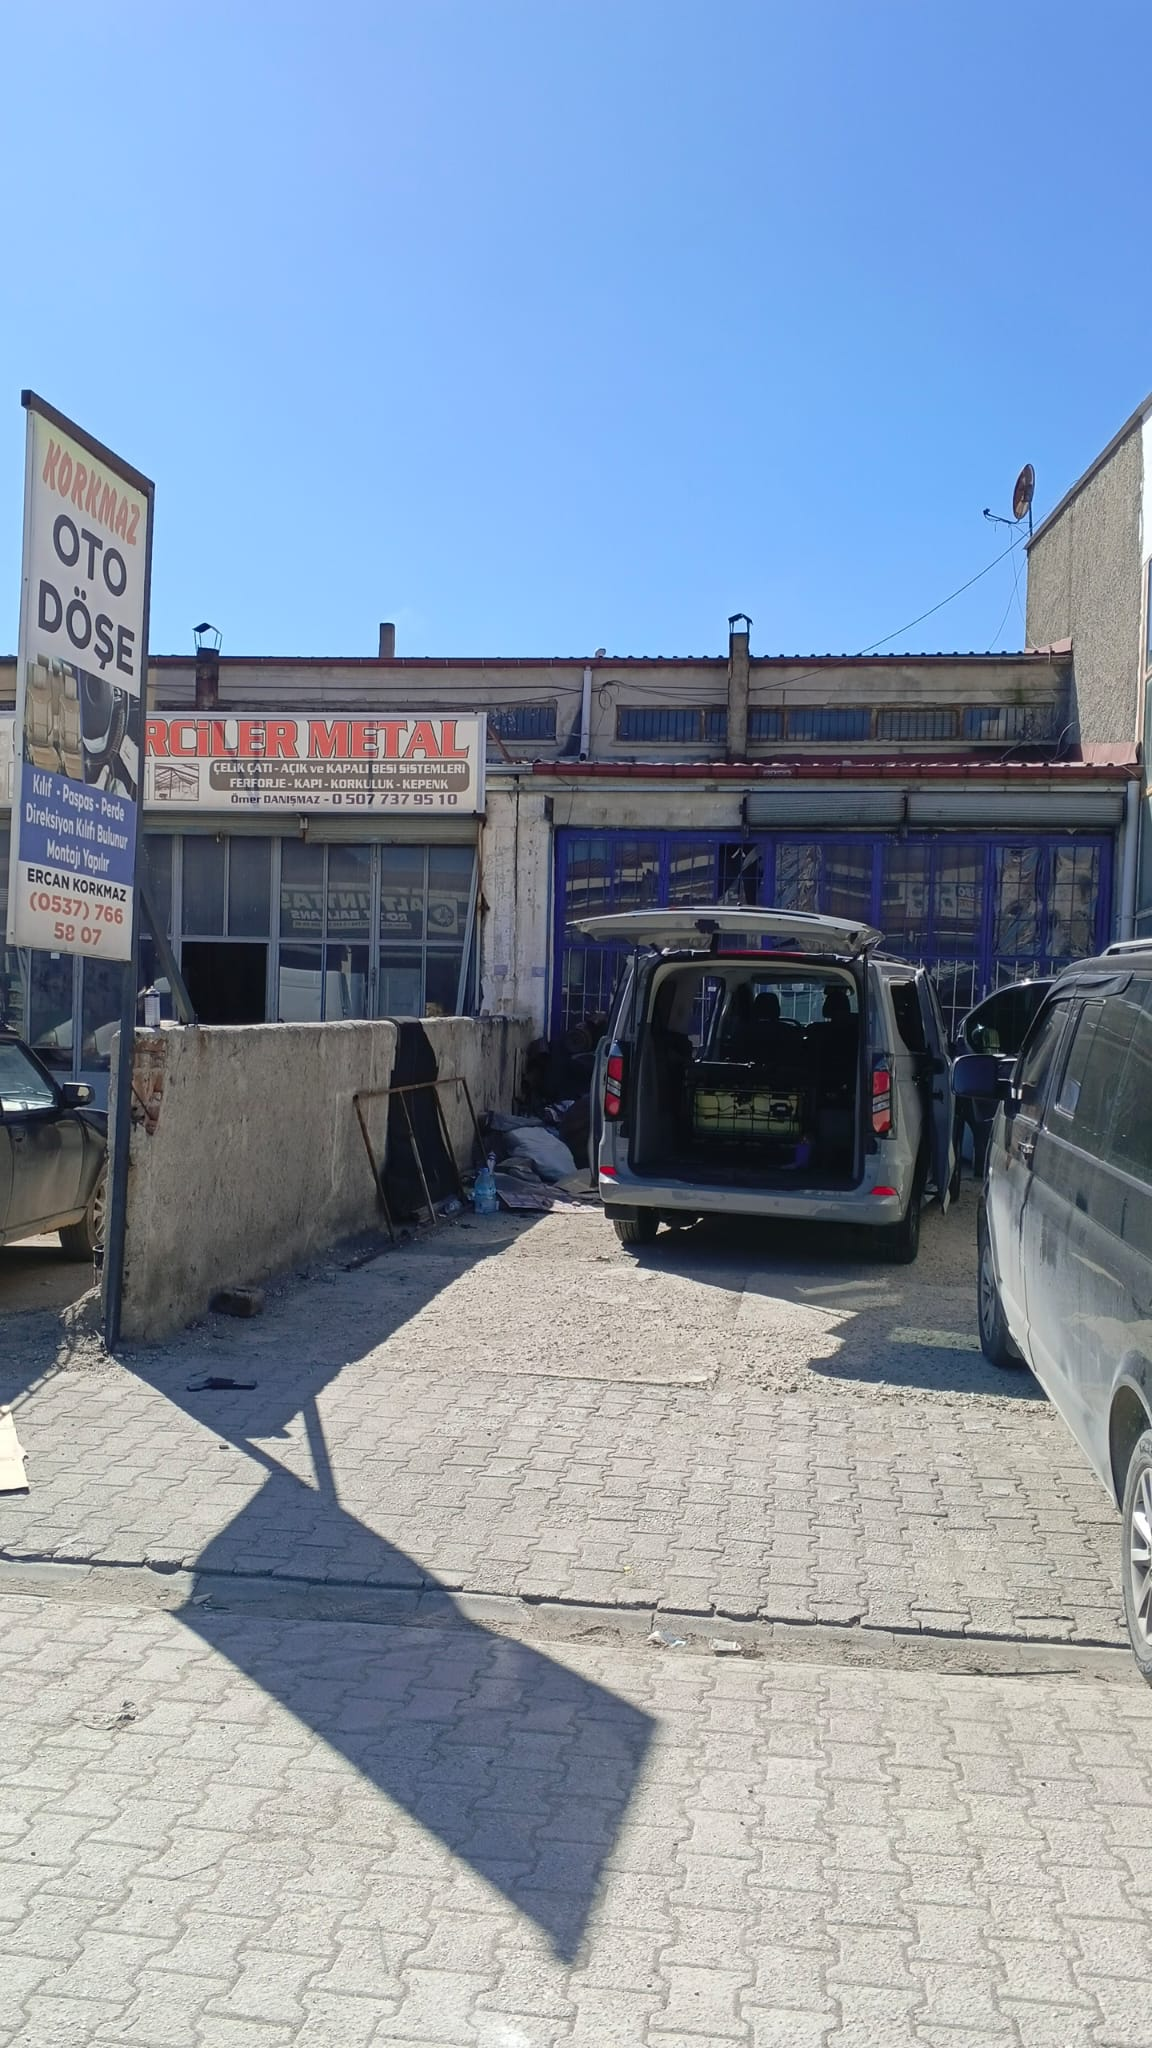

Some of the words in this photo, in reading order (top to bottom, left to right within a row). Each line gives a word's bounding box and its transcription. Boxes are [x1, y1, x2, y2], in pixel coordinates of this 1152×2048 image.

[42, 438, 140, 546] KORKMAZ
[52, 514, 127, 597] OTO
[37, 579, 135, 676] DÖŞE
[306, 720, 470, 759] METAL
[229, 778, 285, 789] FERFORJE
[294, 778, 322, 789] KAPI
[330, 779, 394, 790] KORKULUK
[402, 779, 449, 790] KEPENK
[247, 762, 273, 776] ÇATI
[281, 762, 308, 776] AÇIK
[310, 766, 324, 774] ve
[326, 763, 369, 774] KAPALI
[62, 783, 94, 813] Paspas
[101, 798, 125, 822] Perde
[230, 793, 262, 804] Ömer
[263, 794, 321, 806] DANIŞMAZ
[332, 794, 342, 805] 0
[345, 794, 375, 805] 507
[380, 794, 410, 805] 737
[413, 794, 434, 805] 95
[438, 795, 458, 805] 10
[26, 802, 74, 836] Direksiyon
[97, 826, 128, 850] Bulunur
[46, 838, 81, 870] Montajı
[27, 867, 70, 891] ERCAN
[72, 878, 127, 902] KORKMAZ
[29, 891, 90, 921] (0537)
[94, 904, 124, 925] 766
[54, 922, 75, 942] 58
[81, 926, 102, 945] 07
